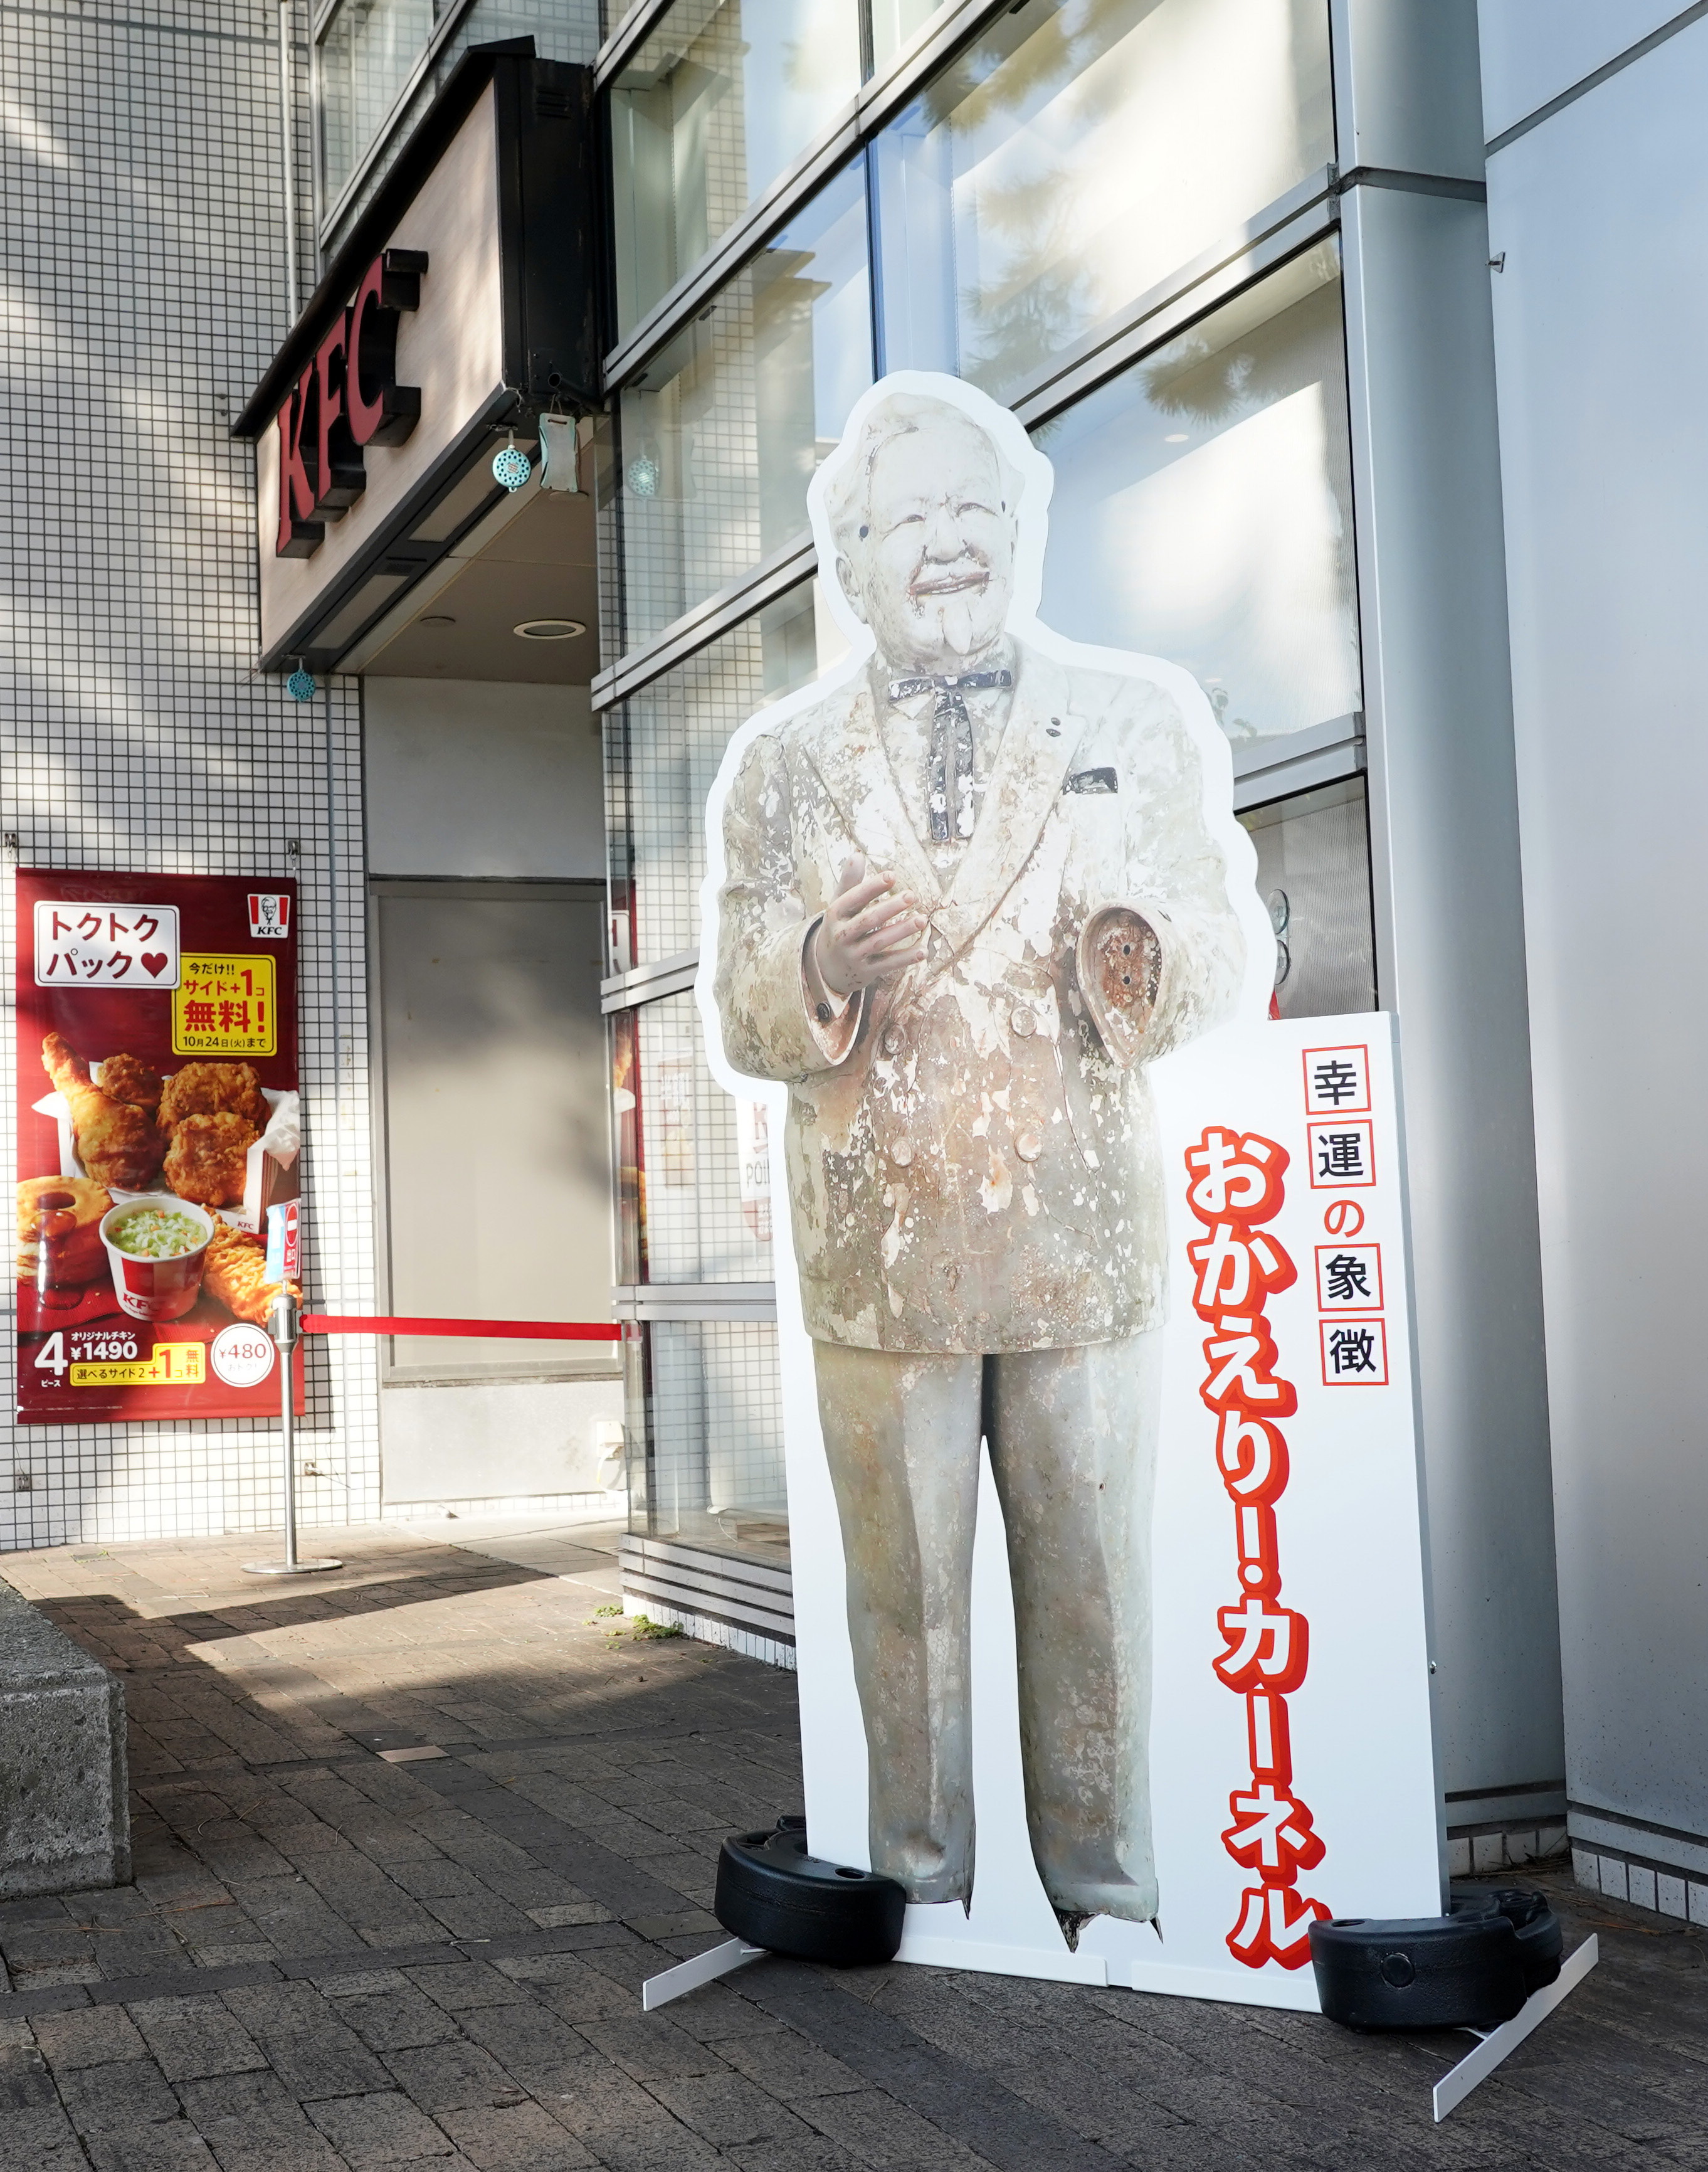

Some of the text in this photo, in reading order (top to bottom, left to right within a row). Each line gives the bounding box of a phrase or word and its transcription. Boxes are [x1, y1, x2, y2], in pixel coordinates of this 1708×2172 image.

[276, 251, 415, 558] KFC
[53, 911, 159, 942] トクトク
[257, 926, 282, 935] KFC
[46, 948, 133, 979] パック
[189, 963, 235, 975] 今だけ!!
[183, 999, 265, 1033] 無料!
[183, 1036, 266, 1048] 10月24日(火)まで
[237, 1221, 254, 1229] KFC
[1314, 1060, 1376, 1374] 幸運の象徴
[71, 1331, 135, 1341] オリジナルチキン
[34, 1332, 68, 1375] 4
[70, 1341, 138, 1360] ¥1490
[219, 1343, 266, 1359] ¥480
[41, 1379, 61, 1387] ピース
[1184, 1126, 1332, 1970] おかえり！カーネル
